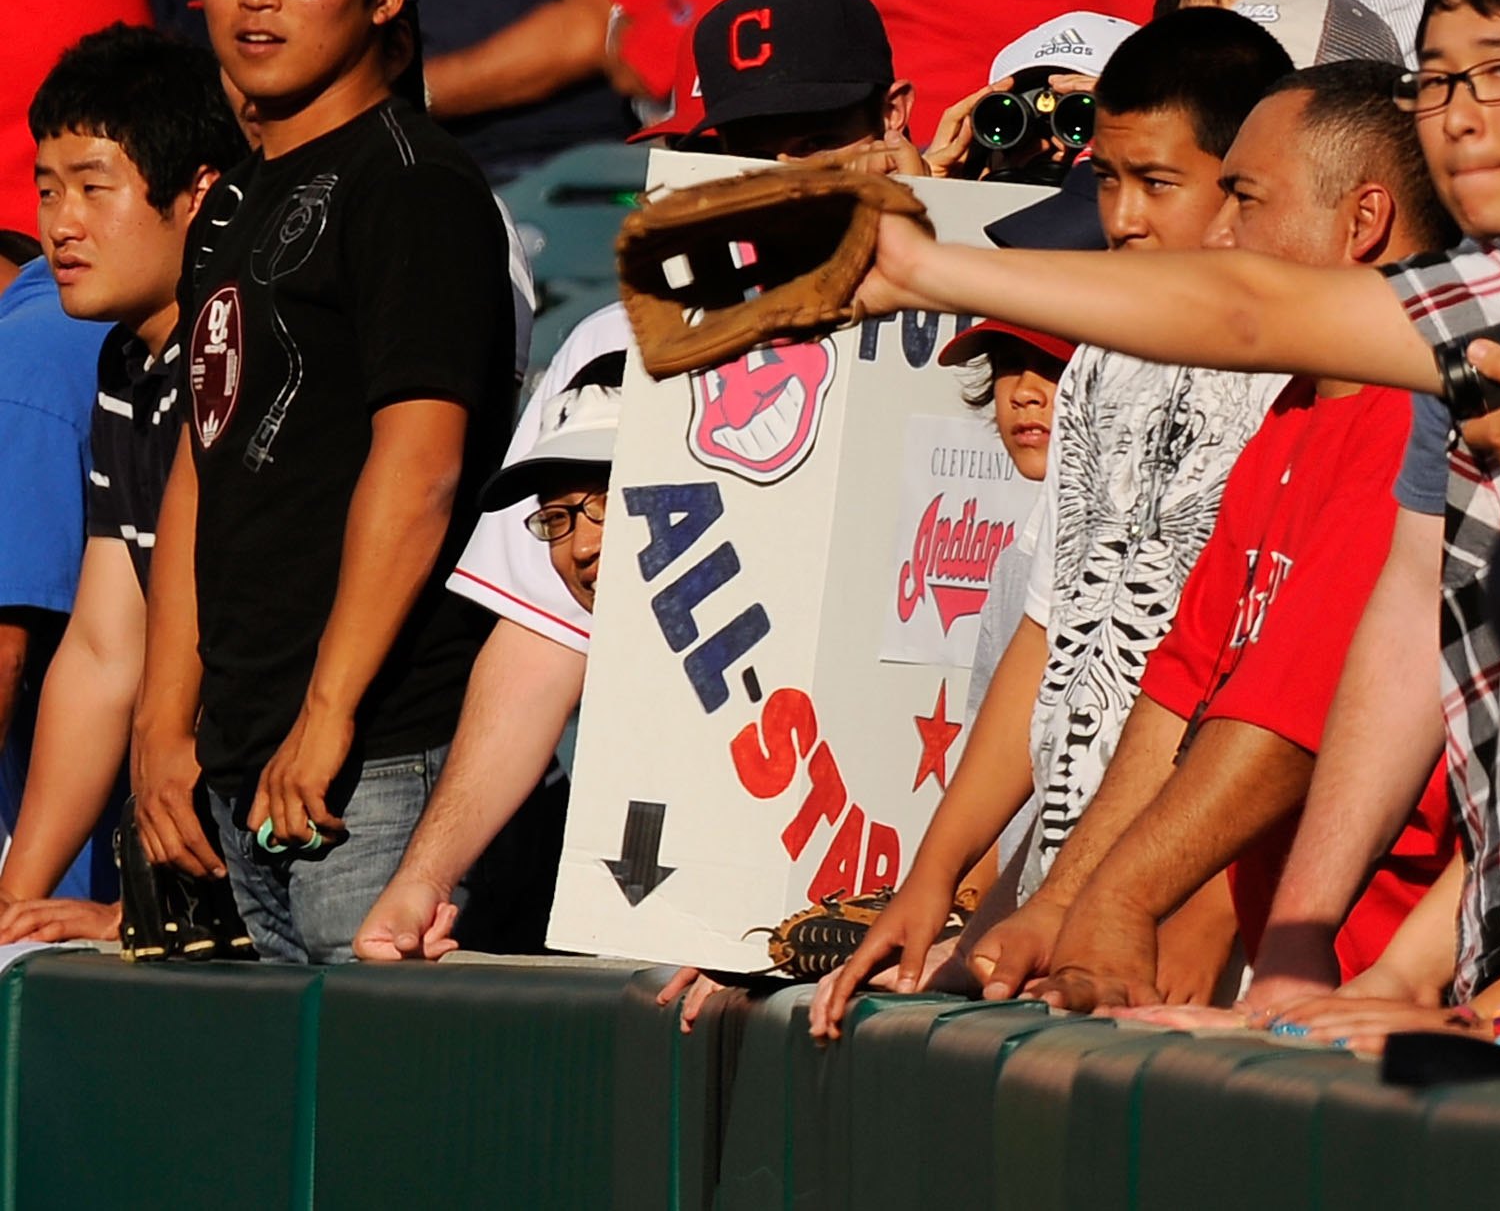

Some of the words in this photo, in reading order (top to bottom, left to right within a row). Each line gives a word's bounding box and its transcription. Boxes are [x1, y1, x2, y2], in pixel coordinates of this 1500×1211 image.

[729, 8, 773, 71] C
[1034, 42, 1094, 59] adidas
[931, 447, 1014, 481] CLEVELAND
